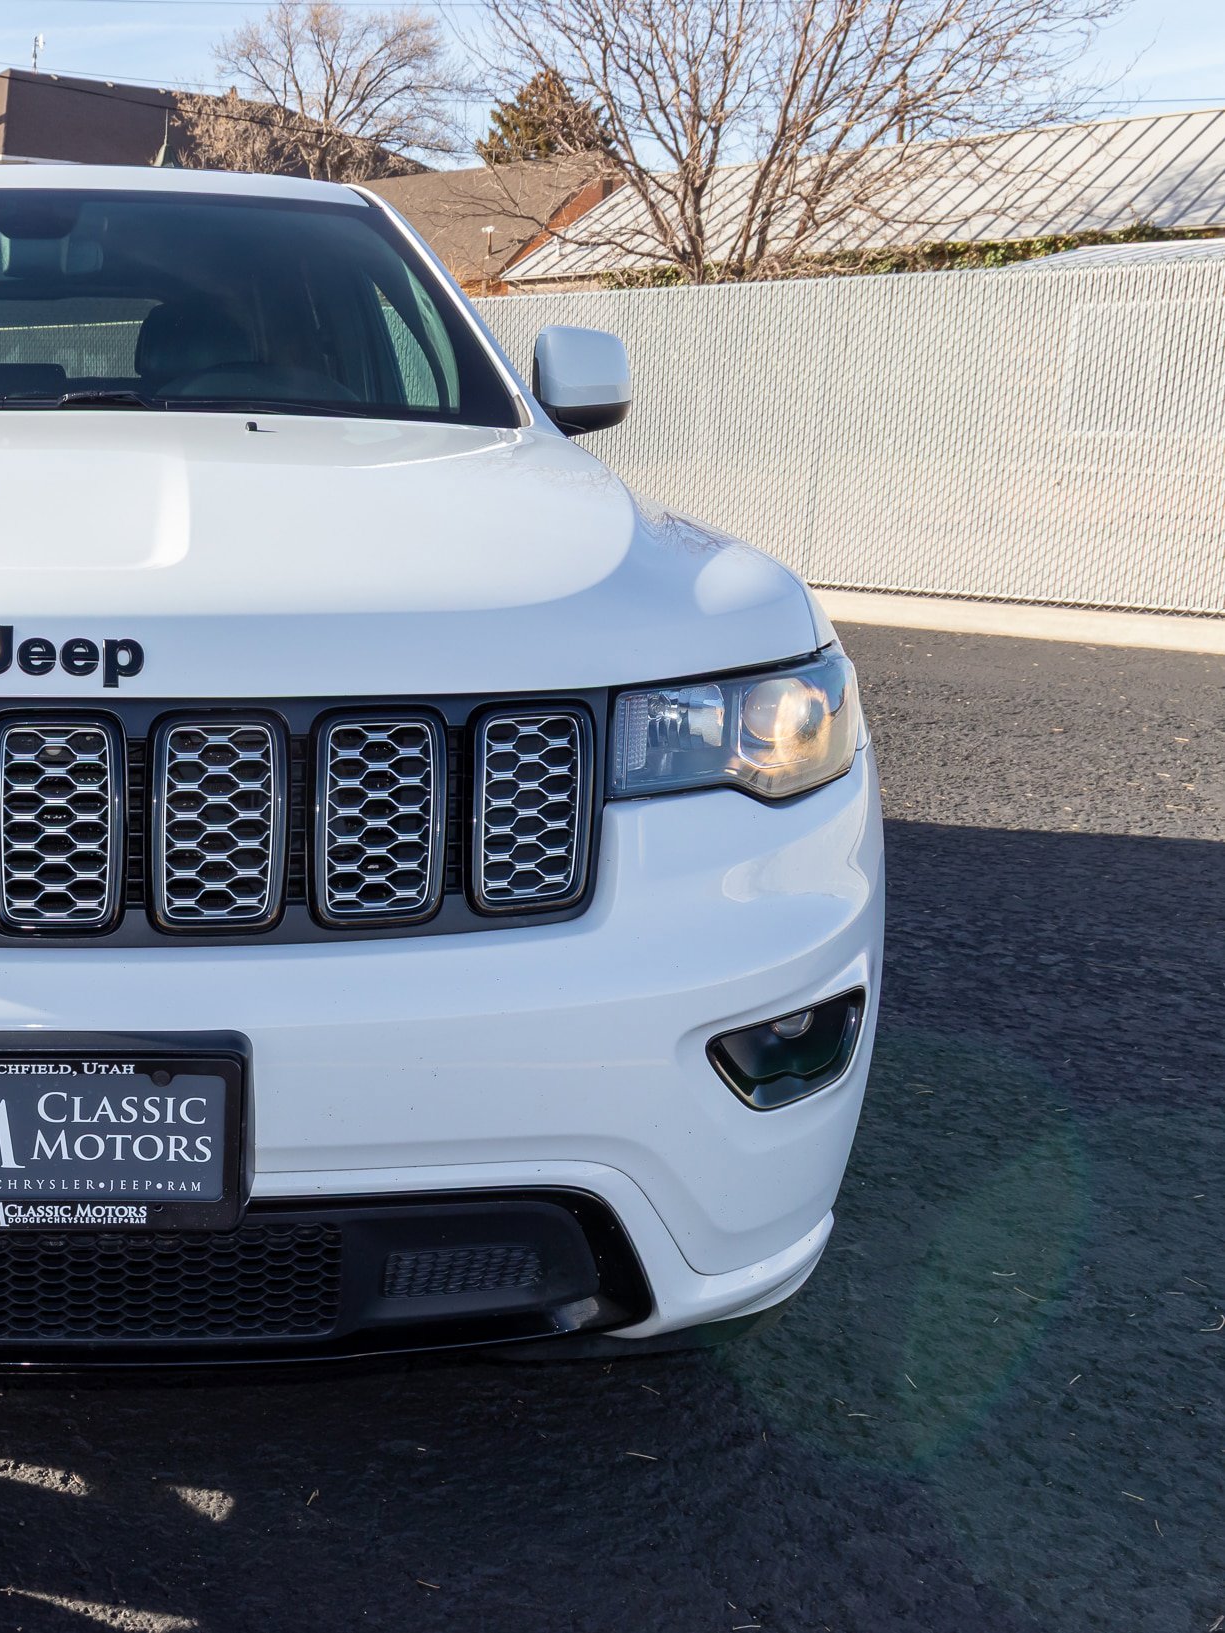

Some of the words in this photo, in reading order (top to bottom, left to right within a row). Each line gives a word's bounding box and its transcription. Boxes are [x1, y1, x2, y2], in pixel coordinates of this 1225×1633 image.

[82, 1062, 135, 1075] UTAH
[36, 1091, 208, 1125] CLASSIC
[30, 1129, 212, 1163] MOTORS
[4, 1203, 72, 1218] CLASSIC
[72, 1203, 148, 1218] MOTORS
